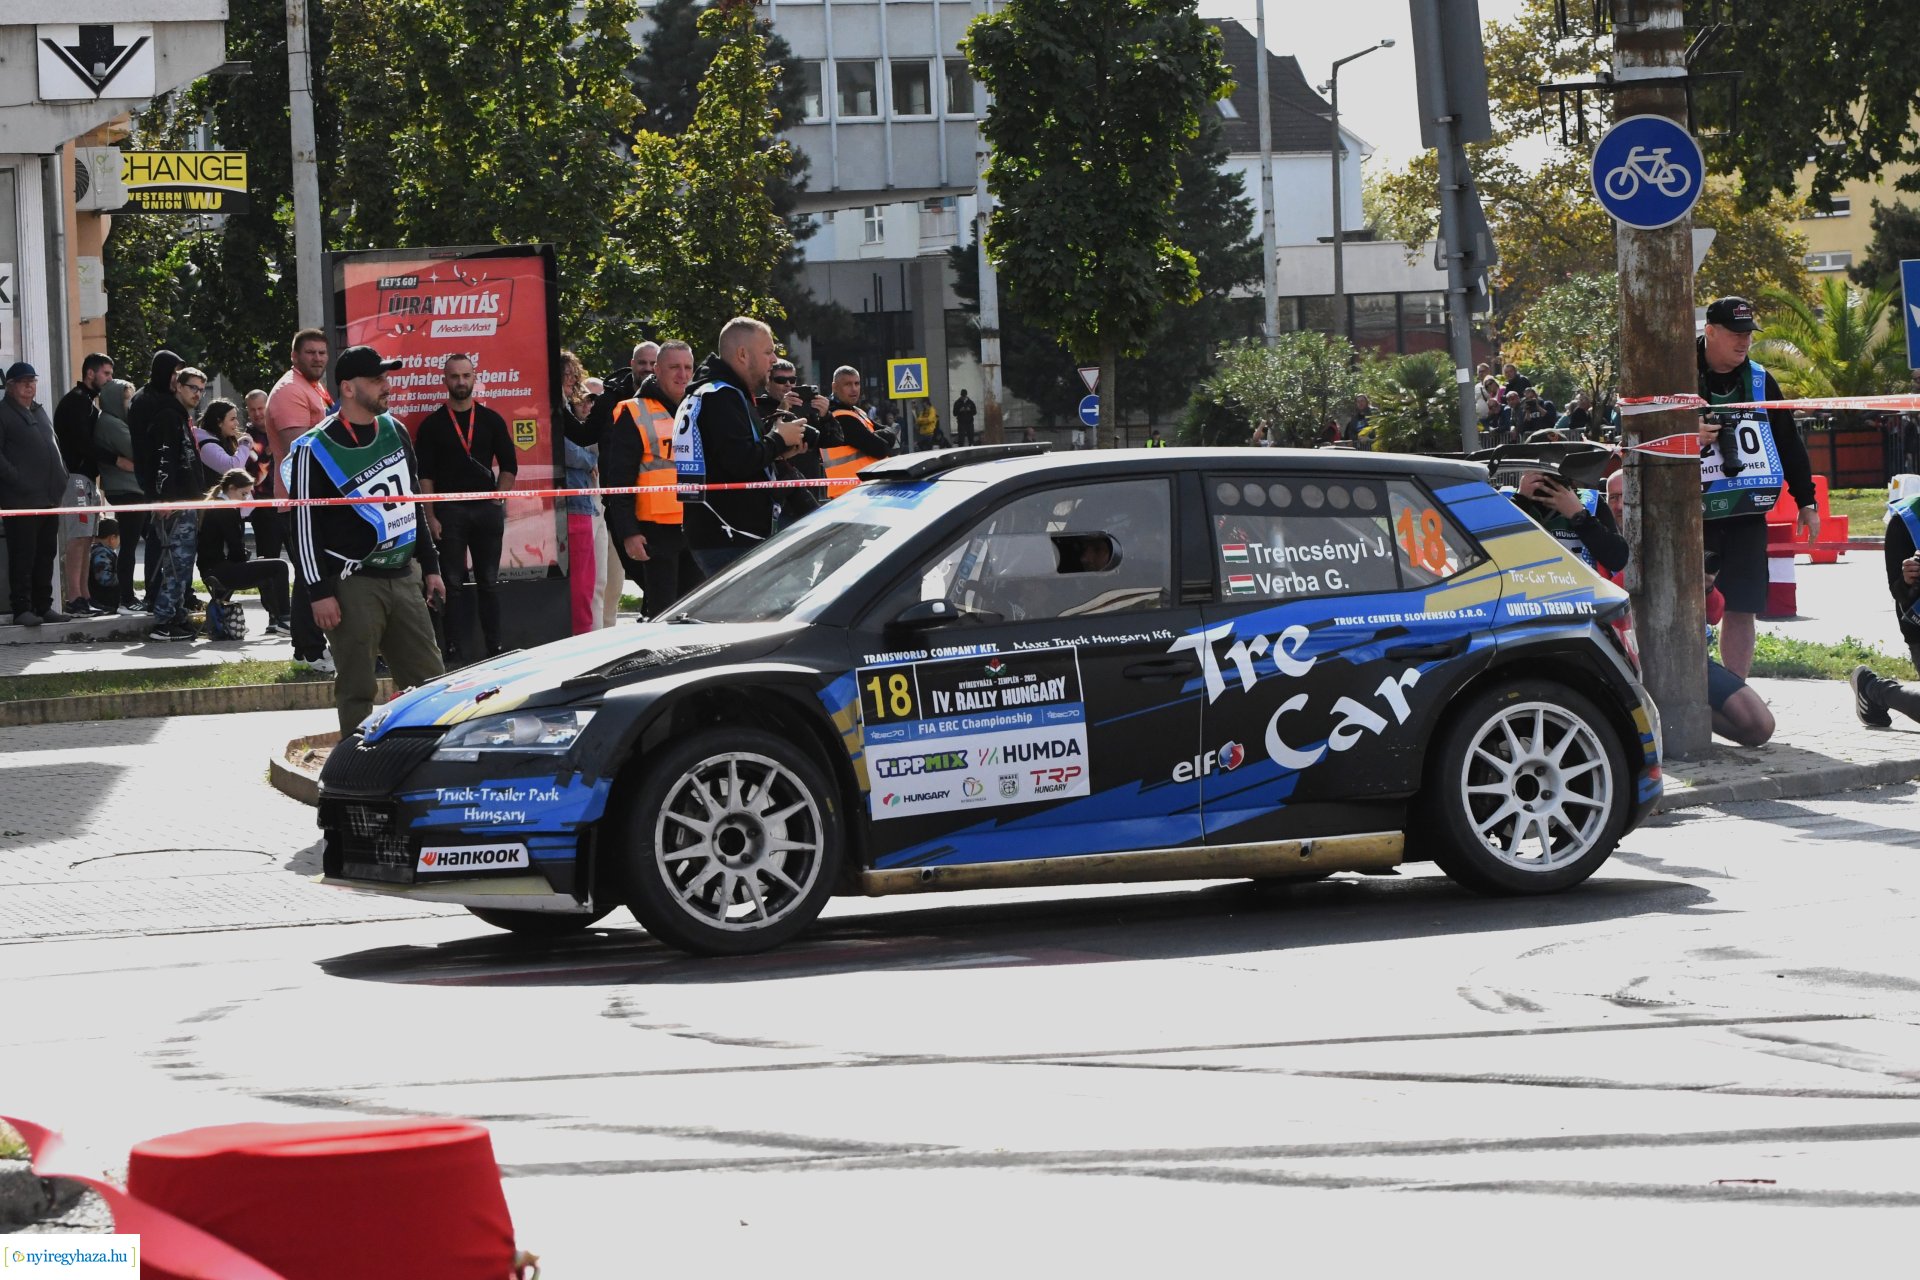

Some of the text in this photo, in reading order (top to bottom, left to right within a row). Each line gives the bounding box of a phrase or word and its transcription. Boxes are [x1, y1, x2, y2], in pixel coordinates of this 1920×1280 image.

[142, 201, 182, 210] UNION
[188, 191, 222, 210] WU
[380, 276, 417, 288] LET'S GO!
[508, 368, 520, 383] is
[515, 422, 534, 434] RS
[363, 460, 385, 478] RALLY
[681, 463, 699, 472] 2023
[1727, 476, 1778, 488] 6-8 OCT 2023
[1397, 507, 1446, 571] 18
[1249, 536, 1393, 565] Trencsényi J.
[1255, 569, 1350, 594] Verba G.
[1508, 569, 1578, 585] Tre-Car Truck
[1334, 608, 1487, 626] TRUCK CENTER SLOVENSKO S.R.O.
[1506, 602, 1597, 617] UNITED TREND KFT.
[1012, 628, 1176, 651] Maxx Truck Hungary Kft.
[863, 642, 1000, 665] TRANSWORLD COMPANY KFT.
[1166, 621, 1318, 706] Tre
[1024, 673, 1037, 683] 2023
[866, 673, 912, 719] 18
[932, 675, 1066, 714] IV. RALLY HUNGARY
[918, 723, 937, 735] FIA
[939, 721, 959, 733] ERC
[961, 711, 1033, 731] Championship
[1264, 666, 1422, 770] Car
[1003, 738, 1081, 764] HUMDA
[1030, 765, 1082, 786] TRP
[1172, 750, 1217, 784] elf
[435, 787, 560, 803] Truck-Trailer Park
[903, 790, 951, 804] HUNGARY
[1034, 783, 1068, 795] HUNGARY
[463, 806, 526, 824] Hungary
